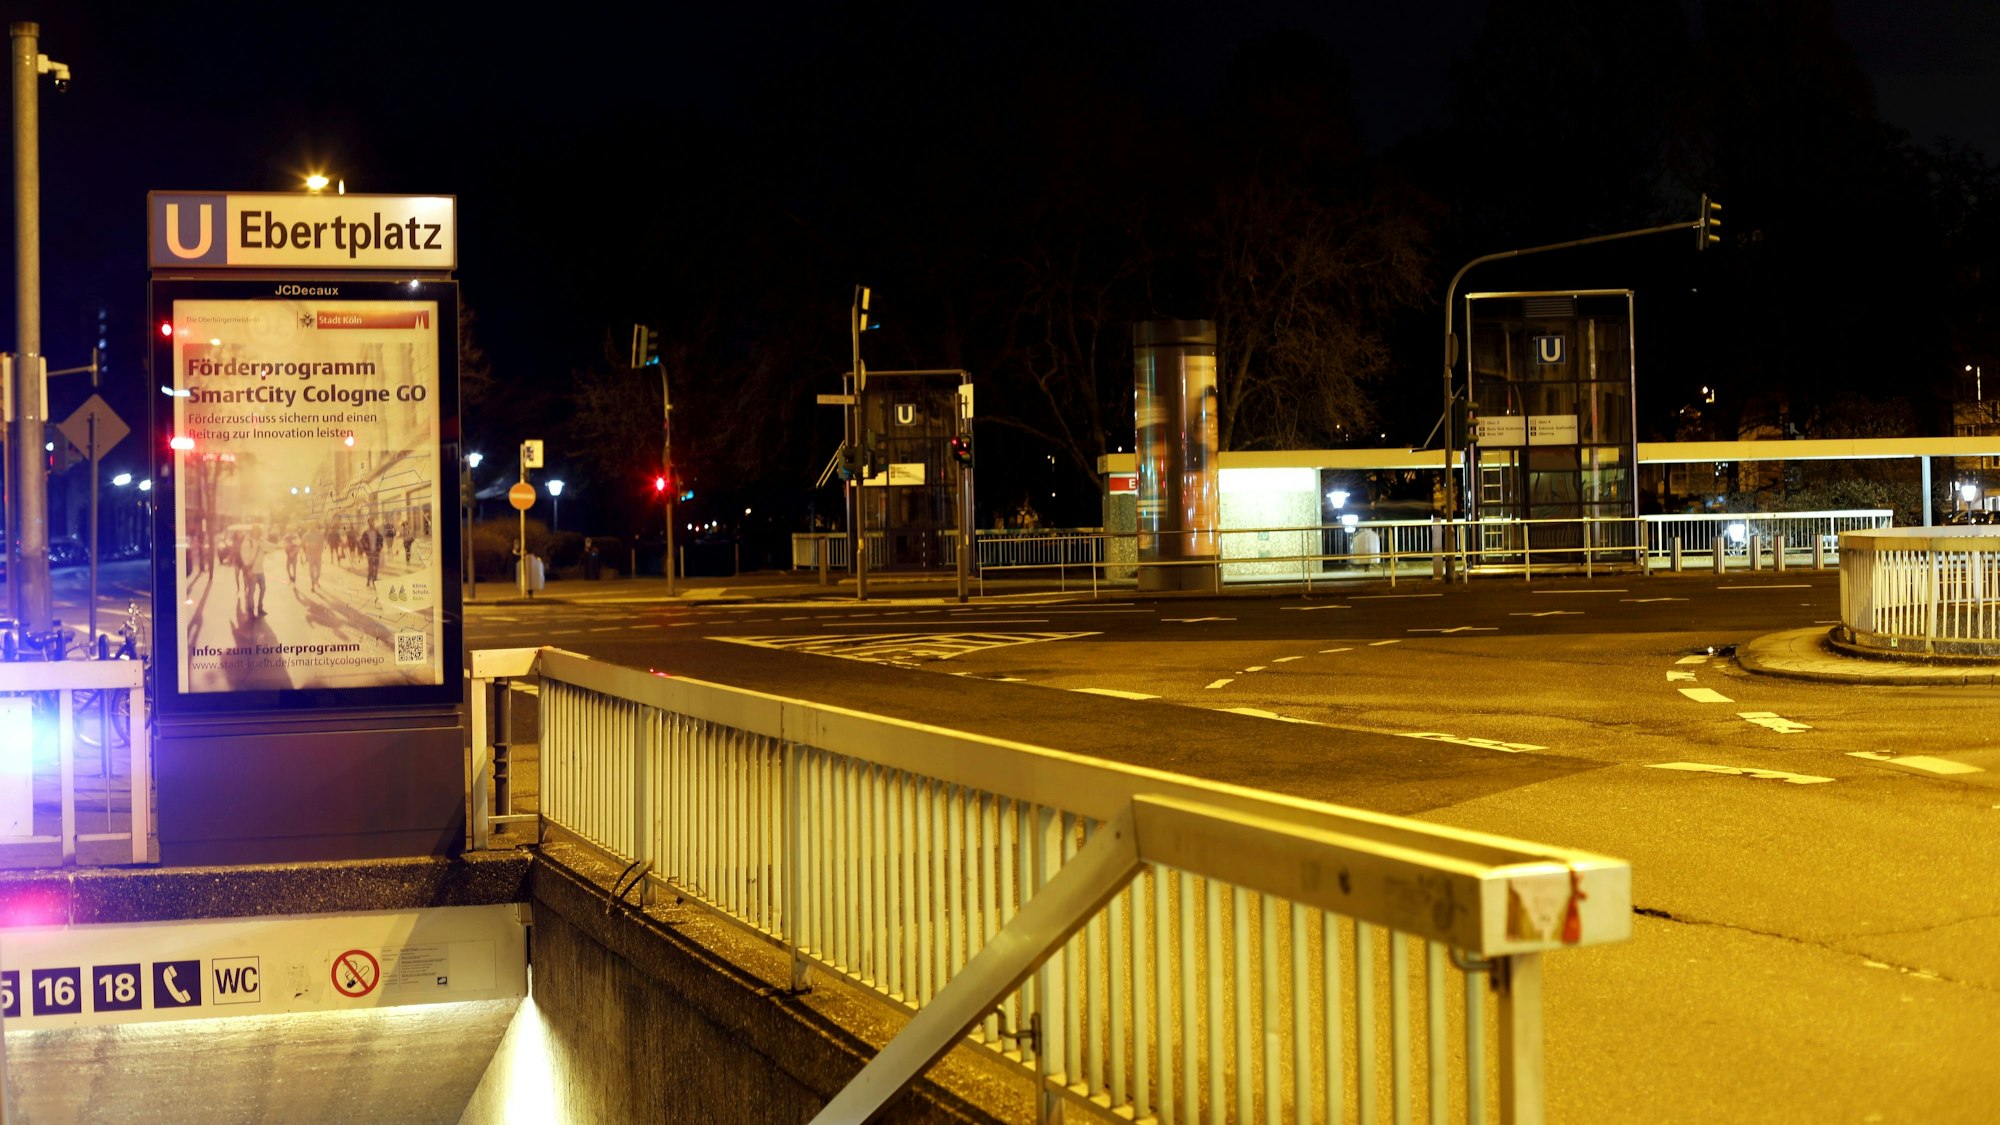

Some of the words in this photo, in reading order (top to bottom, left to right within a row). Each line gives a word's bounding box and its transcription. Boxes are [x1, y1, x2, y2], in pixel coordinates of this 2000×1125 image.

[166, 203, 213, 259] U
[240, 210, 442, 259] Ebertplatz
[275, 284, 339, 296] JCDecaux
[318, 316, 342, 325] Stadt
[343, 315, 362, 325] Köln
[1541, 338, 1561, 362] U
[188, 358, 376, 380] Förderprogramm
[188, 385, 296, 407] SmartCity
[303, 384, 390, 407] Cologne
[397, 385, 427, 402] GO
[188, 412, 276, 424] Förderzuschuss
[279, 412, 320, 423] sichern
[322, 412, 344, 423] und
[346, 412, 377, 423] einen
[898, 405, 913, 424] U
[189, 428, 230, 441] Beitrag
[232, 430, 251, 439] zur
[253, 428, 314, 439] Innovation
[316, 427, 354, 438] leisten
[192, 646, 223, 656] Infos
[226, 647, 252, 655] zum
[255, 642, 360, 657] Förderprogramm
[38, 976, 75, 1007] 16
[98, 972, 136, 1003] 18
[214, 967, 258, 995] WC
